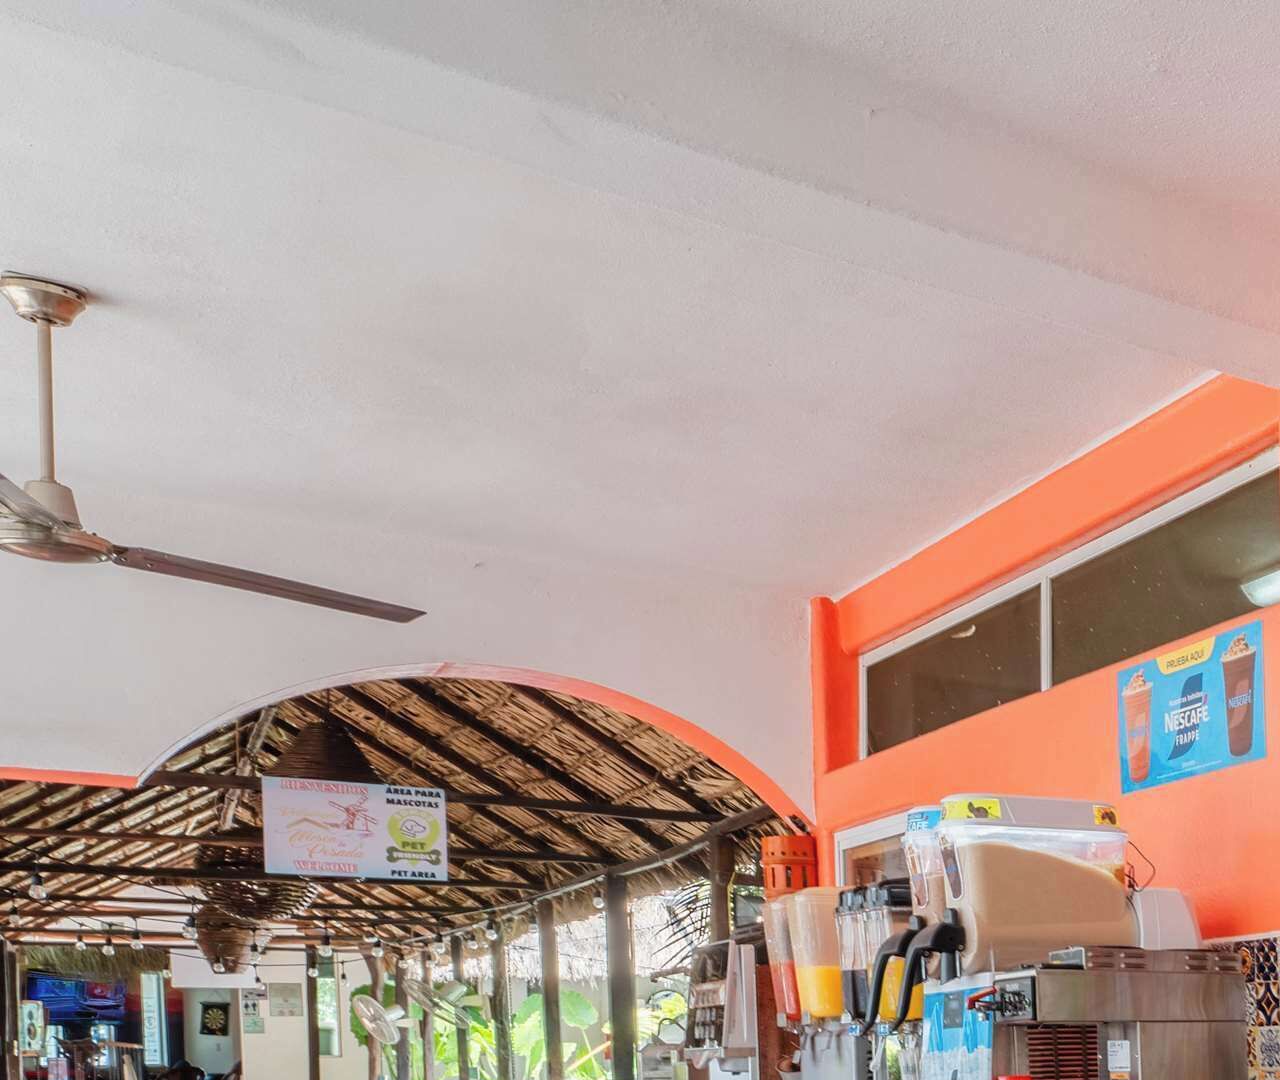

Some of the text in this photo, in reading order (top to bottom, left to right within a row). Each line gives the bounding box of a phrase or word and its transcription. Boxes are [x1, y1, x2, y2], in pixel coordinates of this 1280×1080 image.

[414, 787, 441, 799] PARA
[386, 798, 440, 809] MASCOTAS
[390, 869, 437, 879] PET AREA
